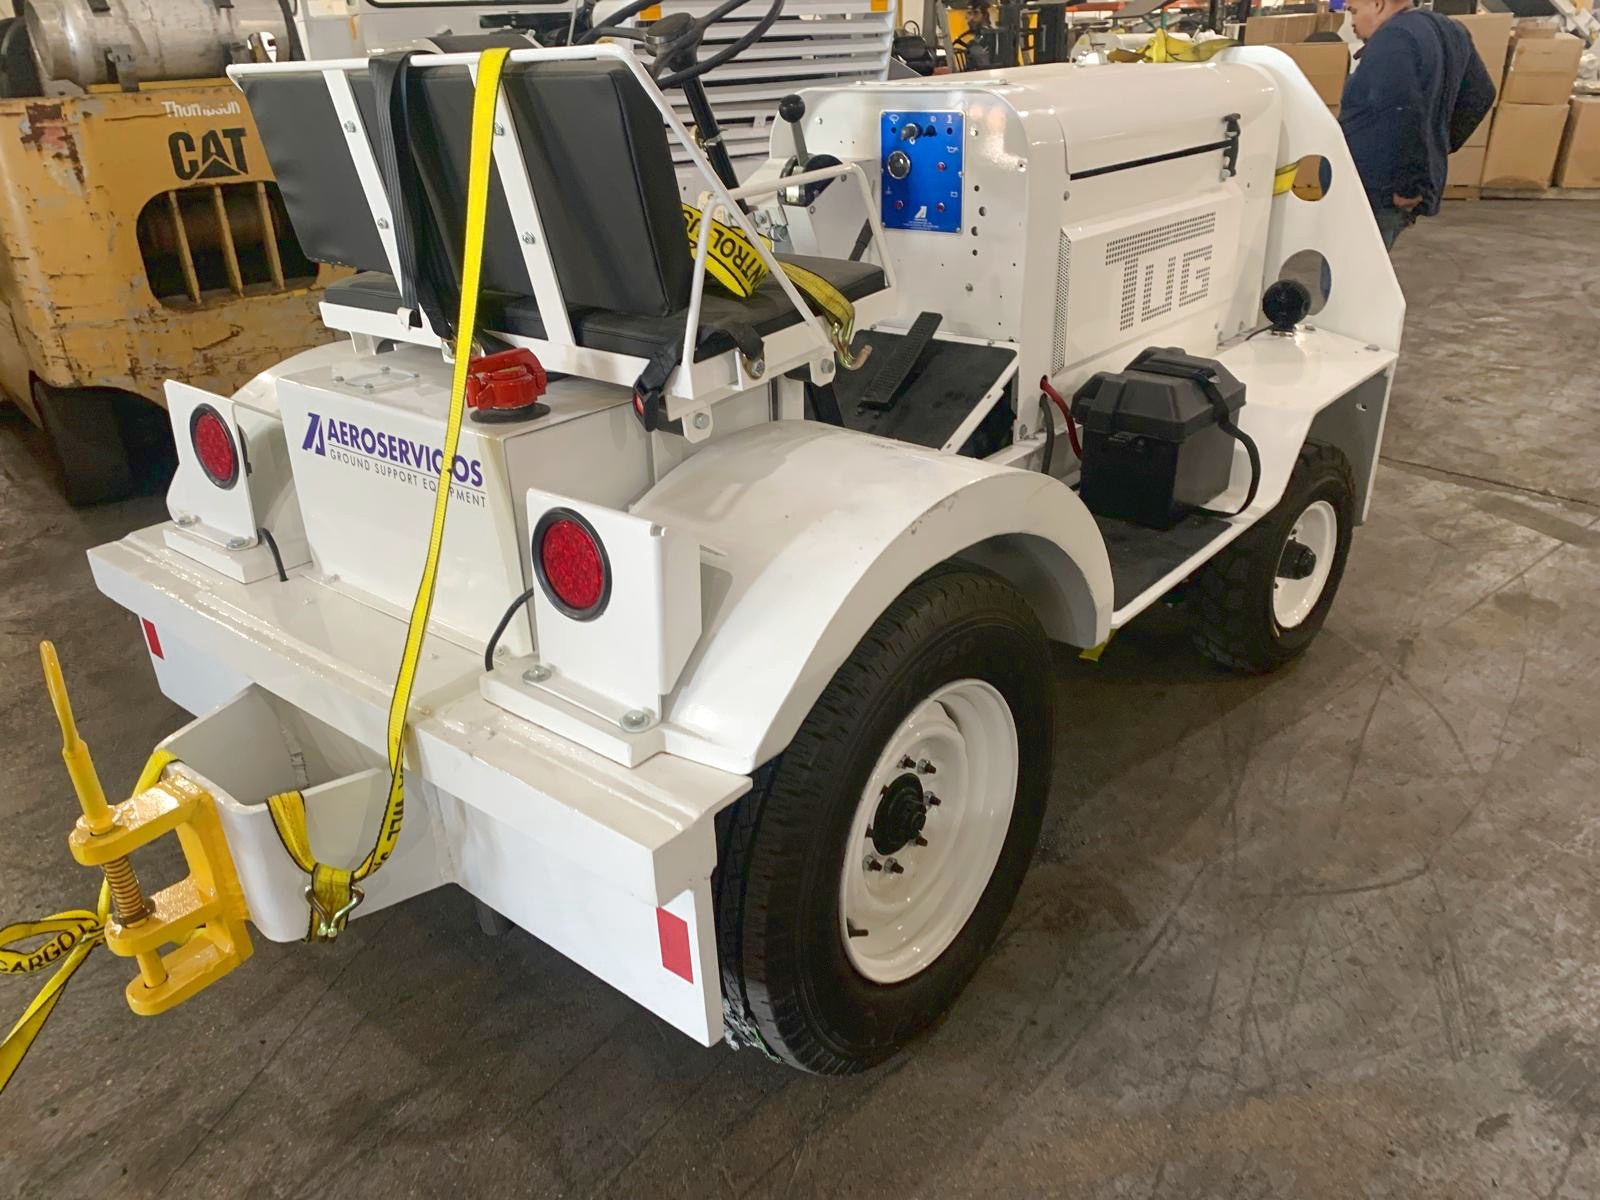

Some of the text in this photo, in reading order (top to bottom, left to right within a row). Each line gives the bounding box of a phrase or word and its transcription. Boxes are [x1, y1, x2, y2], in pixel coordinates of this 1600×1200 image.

[168, 127, 249, 180] CAT
[1105, 211, 1216, 331] TUG
[327, 418, 483, 487] AEROSERVICOS
[330, 449, 486, 508] GROUND SUPPORT EQPMENT
